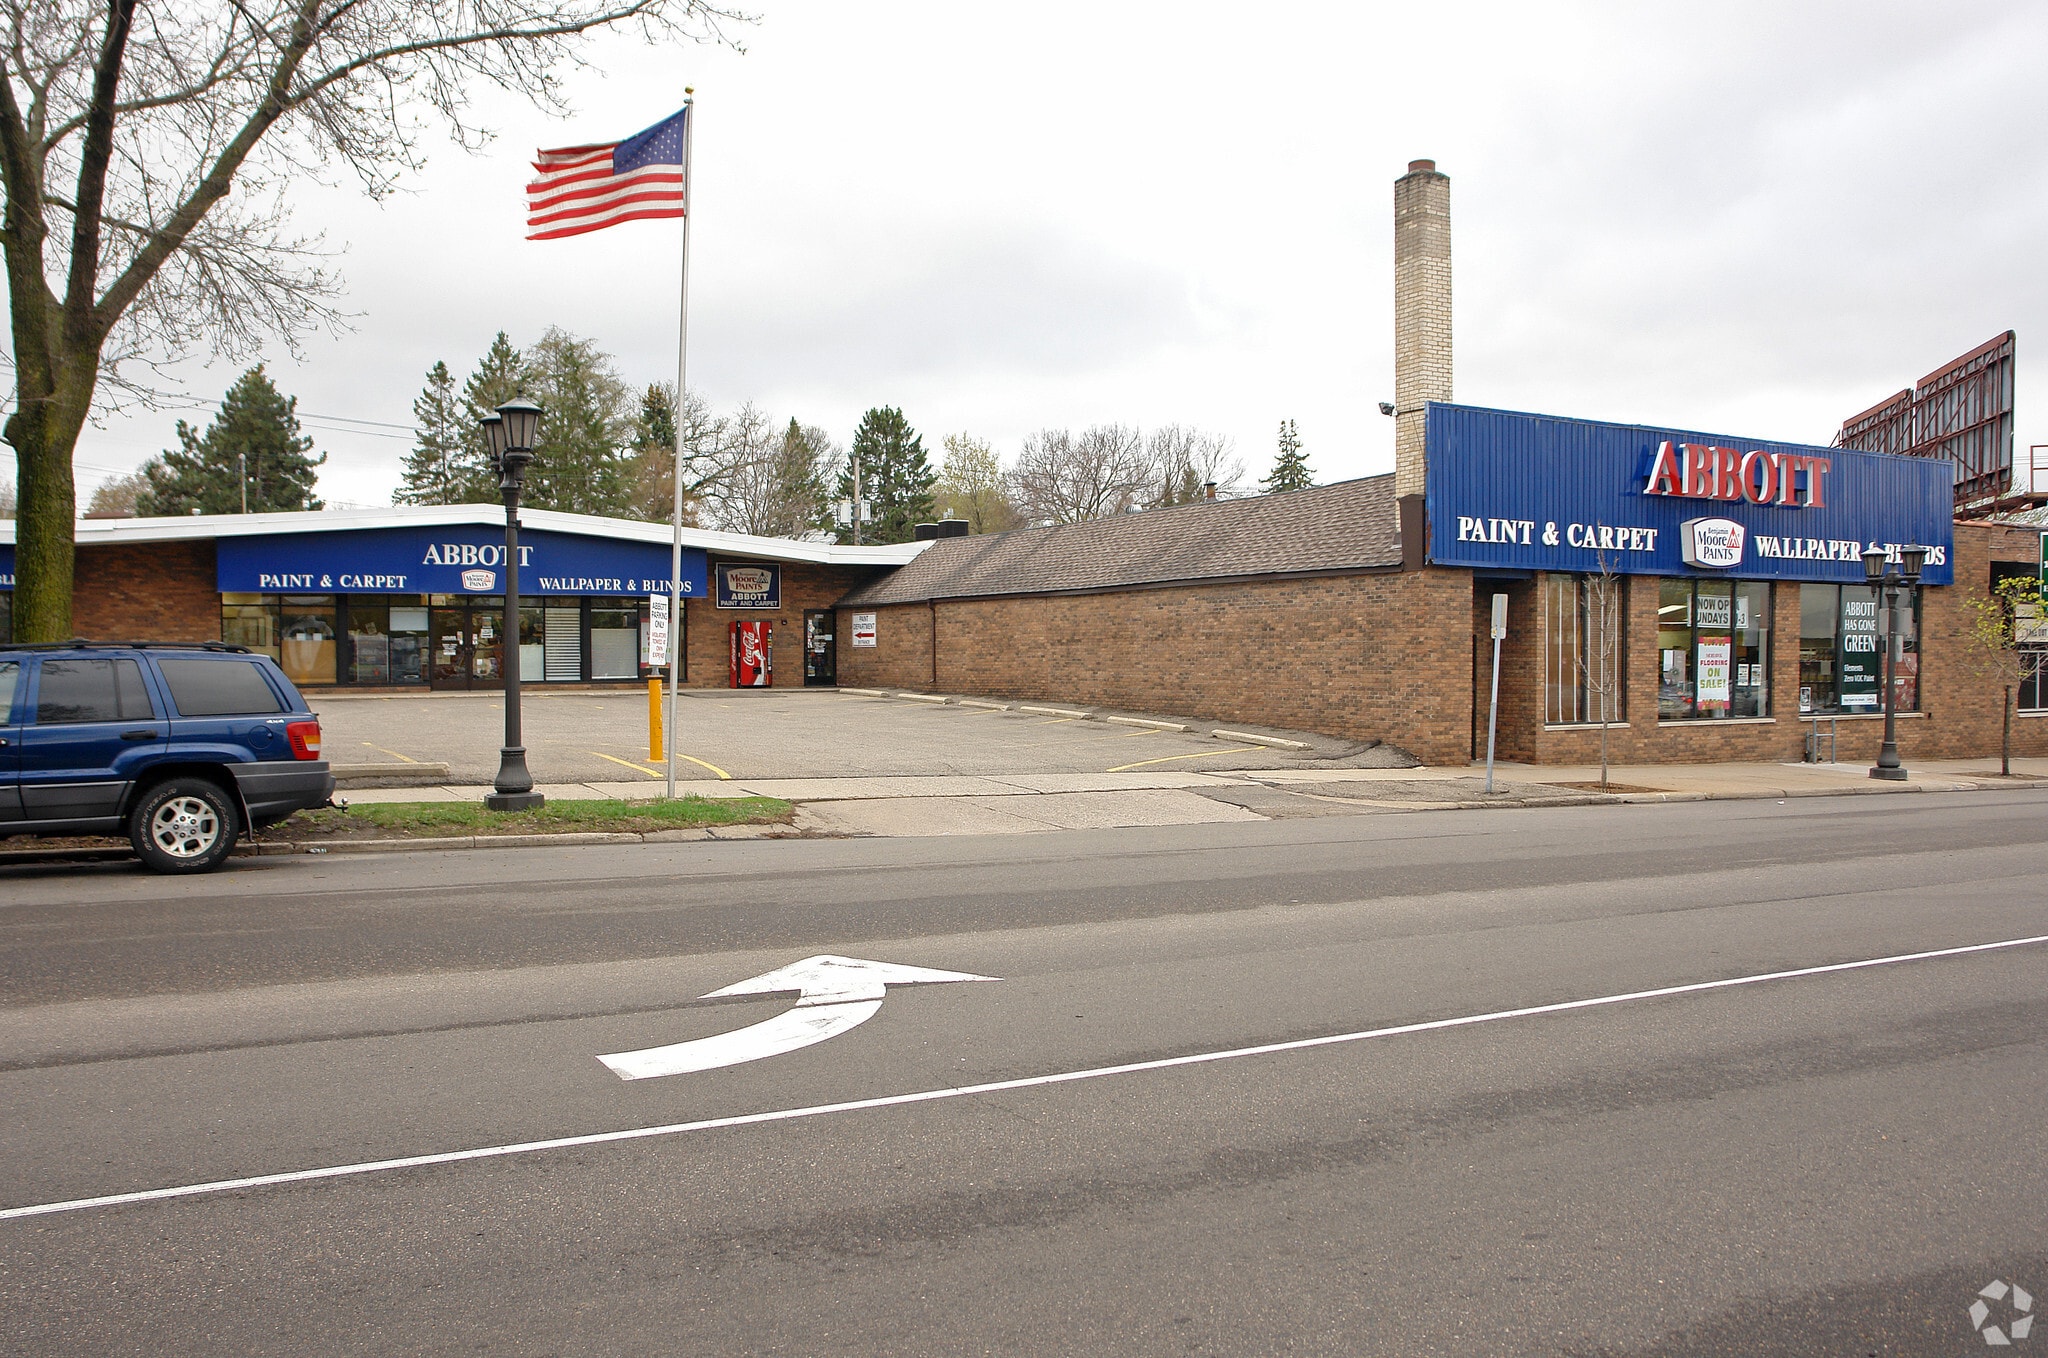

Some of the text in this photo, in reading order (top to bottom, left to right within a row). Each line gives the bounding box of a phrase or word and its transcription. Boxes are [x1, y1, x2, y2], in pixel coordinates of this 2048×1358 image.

[1643, 440, 1831, 507] ABBOTT
[1457, 516, 1658, 552] PAINT & CARPET
[1697, 530, 1727, 546] Moore
[422, 543, 534, 567] ABBOTT
[1703, 546, 1734, 560] PAINTS
[1754, 535, 1946, 566] WALLPAPER BLDS
[259, 574, 407, 588] PAINT & CARPET
[538, 577, 622, 591] WALLPAPER
[627, 579, 637, 591] &
[730, 574, 757, 583] Moore
[735, 582, 763, 590] PAINTS
[1698, 598, 1715, 610] NOW
[1844, 601, 1876, 616] ABBOTT
[1697, 611, 1729, 624] UNDAYS
[1844, 620, 1876, 631] HAS GONE
[743, 630, 755, 666] Coca-Cola
[1844, 635, 1876, 652] GREEN
[1707, 668, 1720, 677] ON
[1700, 679, 1726, 689] SALE!
